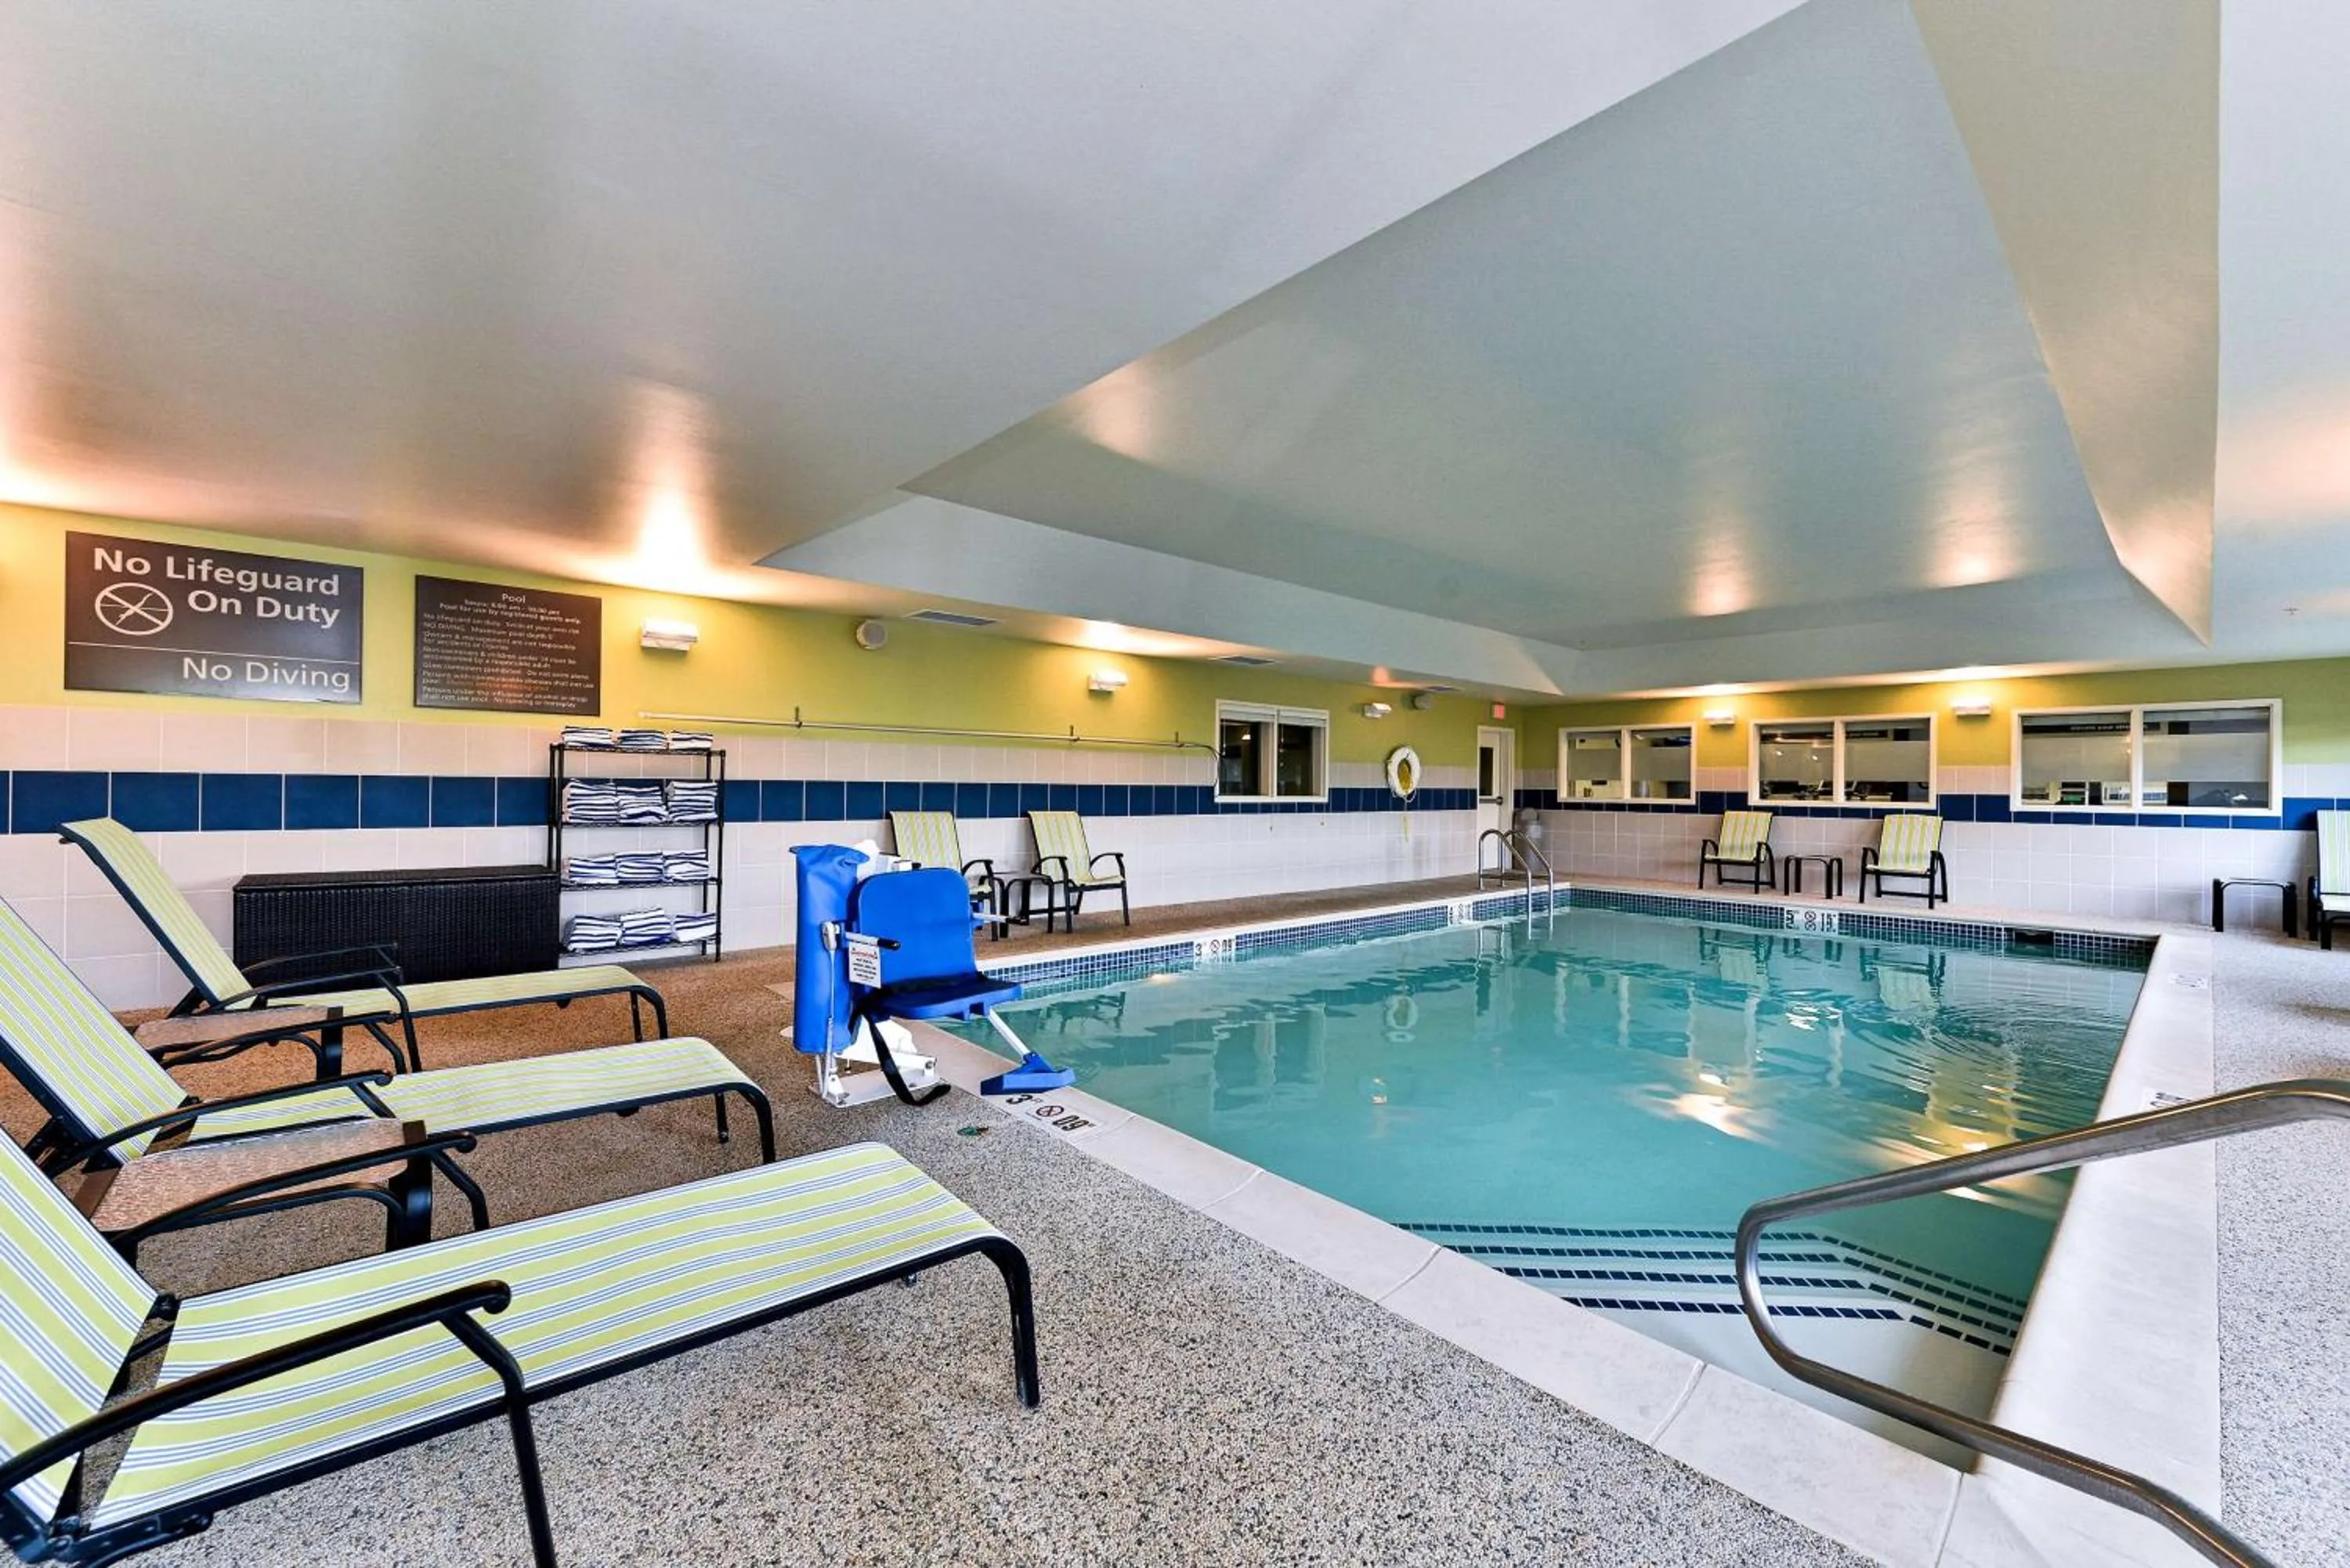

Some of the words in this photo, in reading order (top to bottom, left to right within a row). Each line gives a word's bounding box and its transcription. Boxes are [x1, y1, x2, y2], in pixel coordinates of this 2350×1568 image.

[93, 547, 151, 575] No
[166, 556, 340, 595] Lifeguard
[501, 592, 525, 603] Pool
[188, 591, 242, 615] On
[257, 595, 340, 629] Duty
[183, 658, 233, 681] No
[246, 661, 350, 693] Diving
[1195, 943, 1202, 956] 3
[1006, 1094, 1032, 1104] 3
